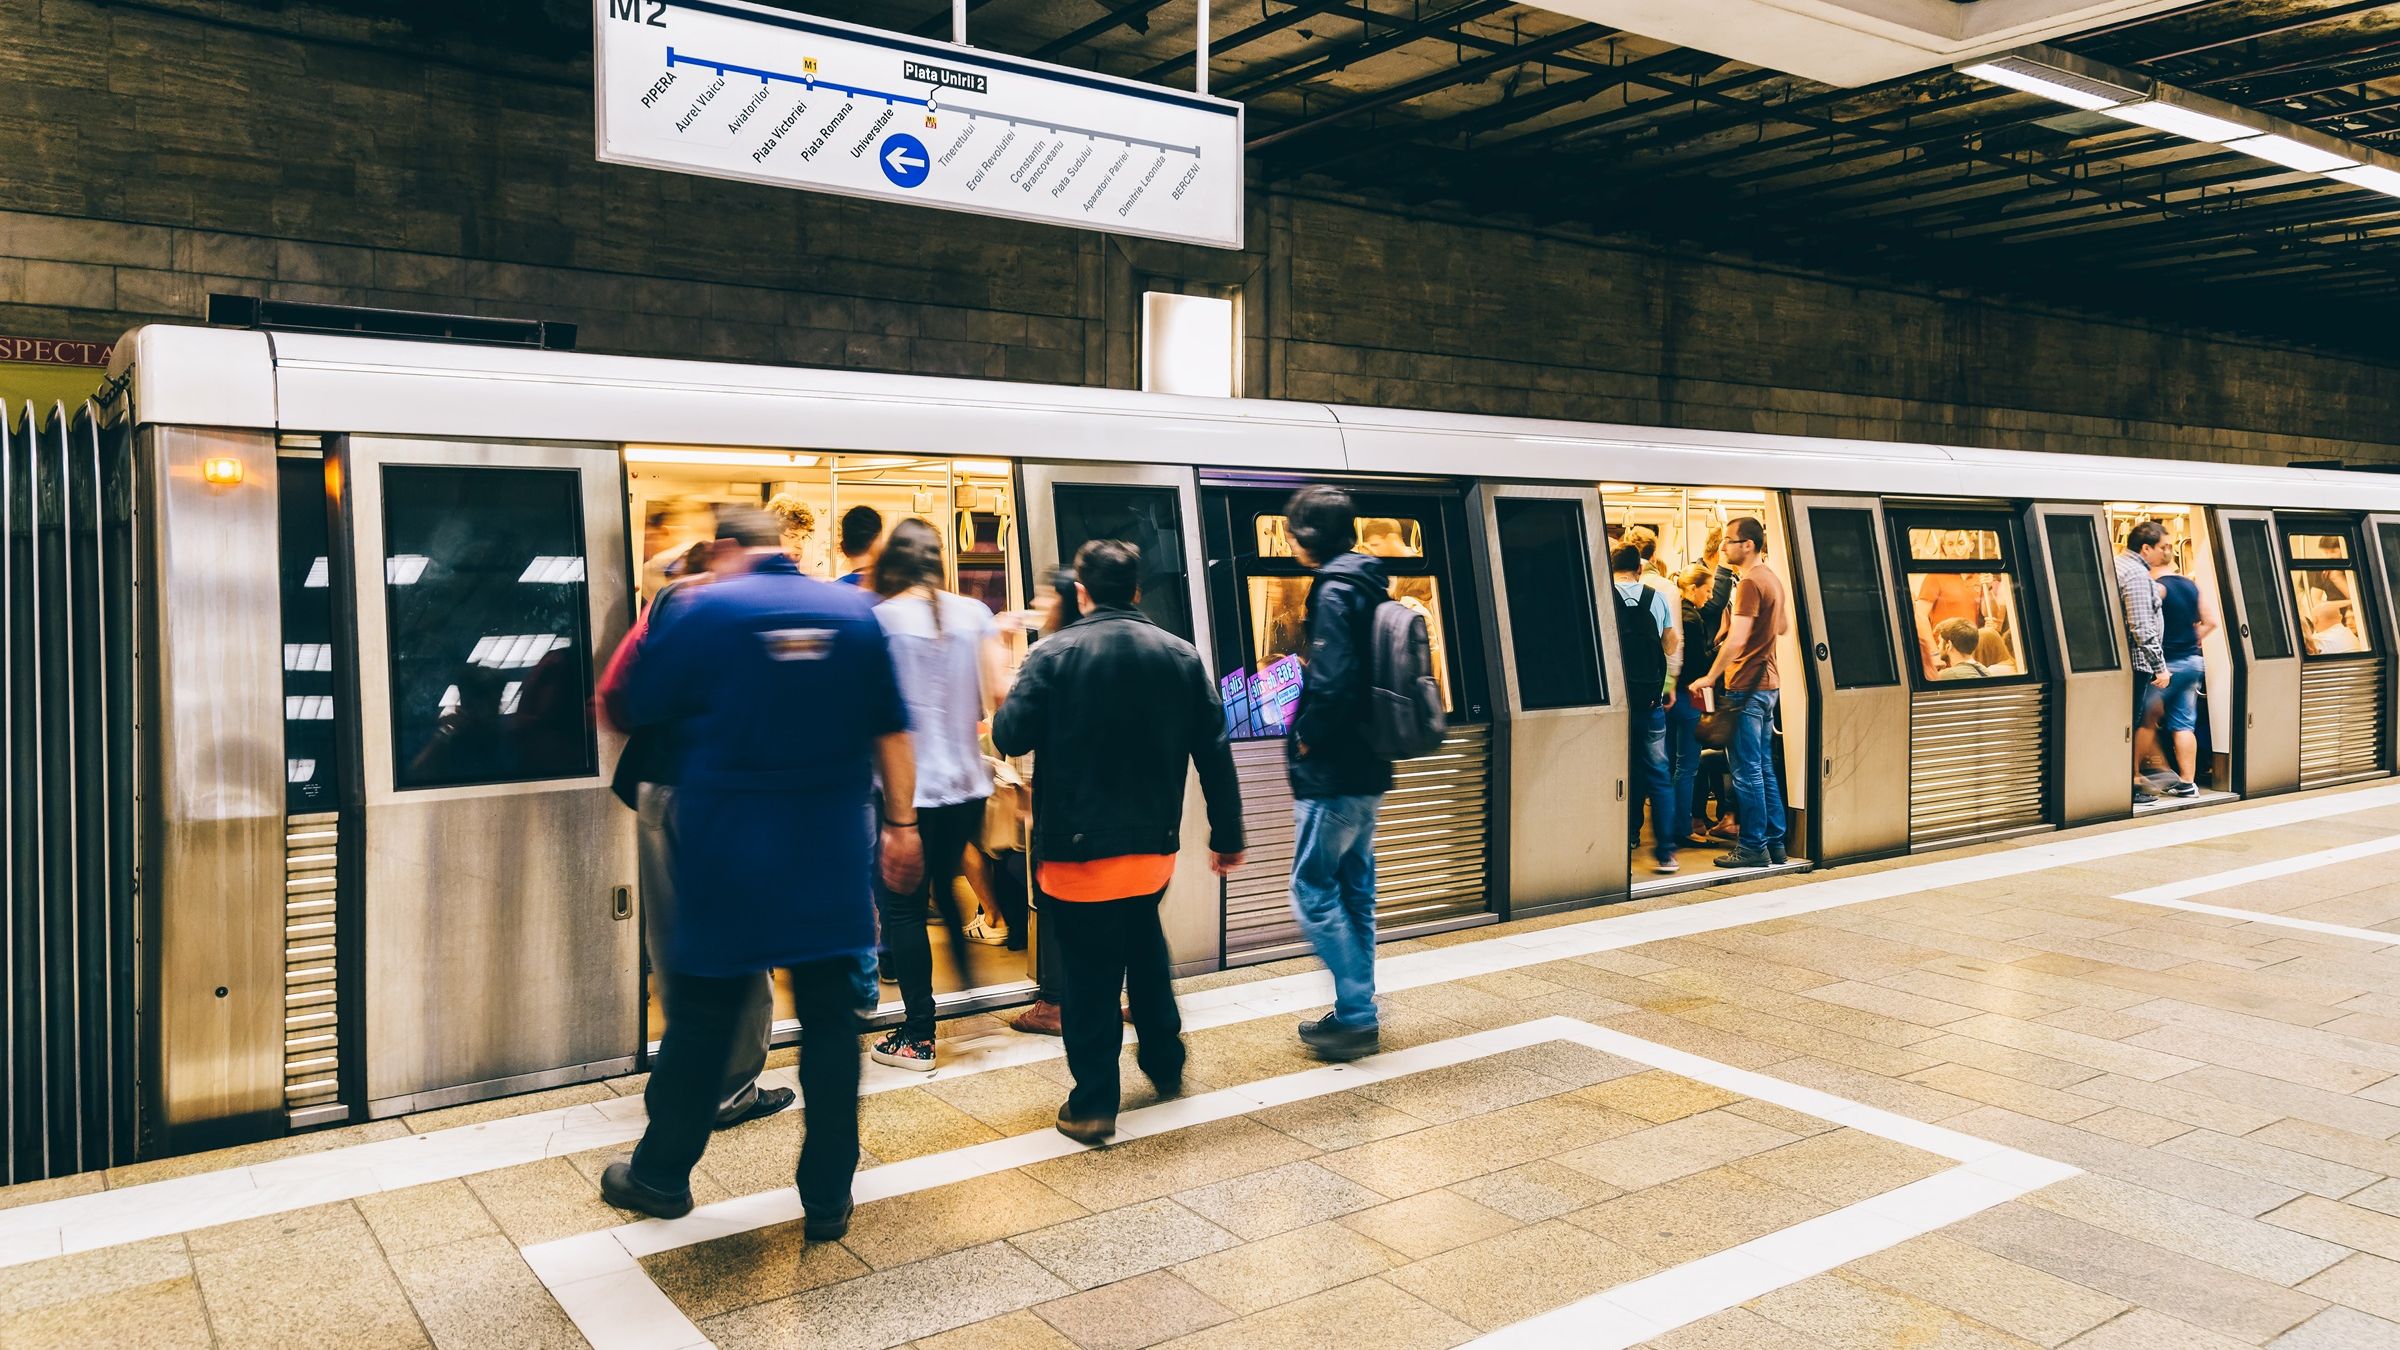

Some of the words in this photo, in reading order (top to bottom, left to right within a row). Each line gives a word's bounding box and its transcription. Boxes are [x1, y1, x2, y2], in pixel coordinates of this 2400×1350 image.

[610, 0, 667, 29] M2
[640, 71, 677, 108] PIPERA
[804, 60, 817, 70] M1
[905, 63, 938, 81] Piata
[941, 69, 975, 89] Unirii
[977, 77, 985, 90] 2
[675, 103, 702, 133] Aurel
[696, 78, 725, 106] Vlaicu
[728, 86, 770, 135] Aviatorilor
[752, 138, 777, 164] Piata
[771, 99, 808, 140] Victoriei
[800, 137, 825, 162] Piata
[819, 102, 853, 140] Romana
[850, 108, 894, 158] Universitate
[938, 121, 976, 167] Tineretului
[965, 168, 985, 191] Eroii
[981, 129, 1016, 172] Revolutiei
[1010, 140, 1046, 184] Constantin
[1022, 140, 1064, 193] Brancoveanu
[1051, 175, 1071, 198] Piata
[1067, 144, 1093, 178] Sudului
[1082, 173, 1112, 213] Aparatorii
[1108, 150, 1129, 177] Patriei
[1171, 162, 1201, 201] BERCENI
[1118, 186, 1144, 217] Dimitrie
[1140, 155, 1166, 188] Leonida
[0, 337, 114, 364] SPECTA
